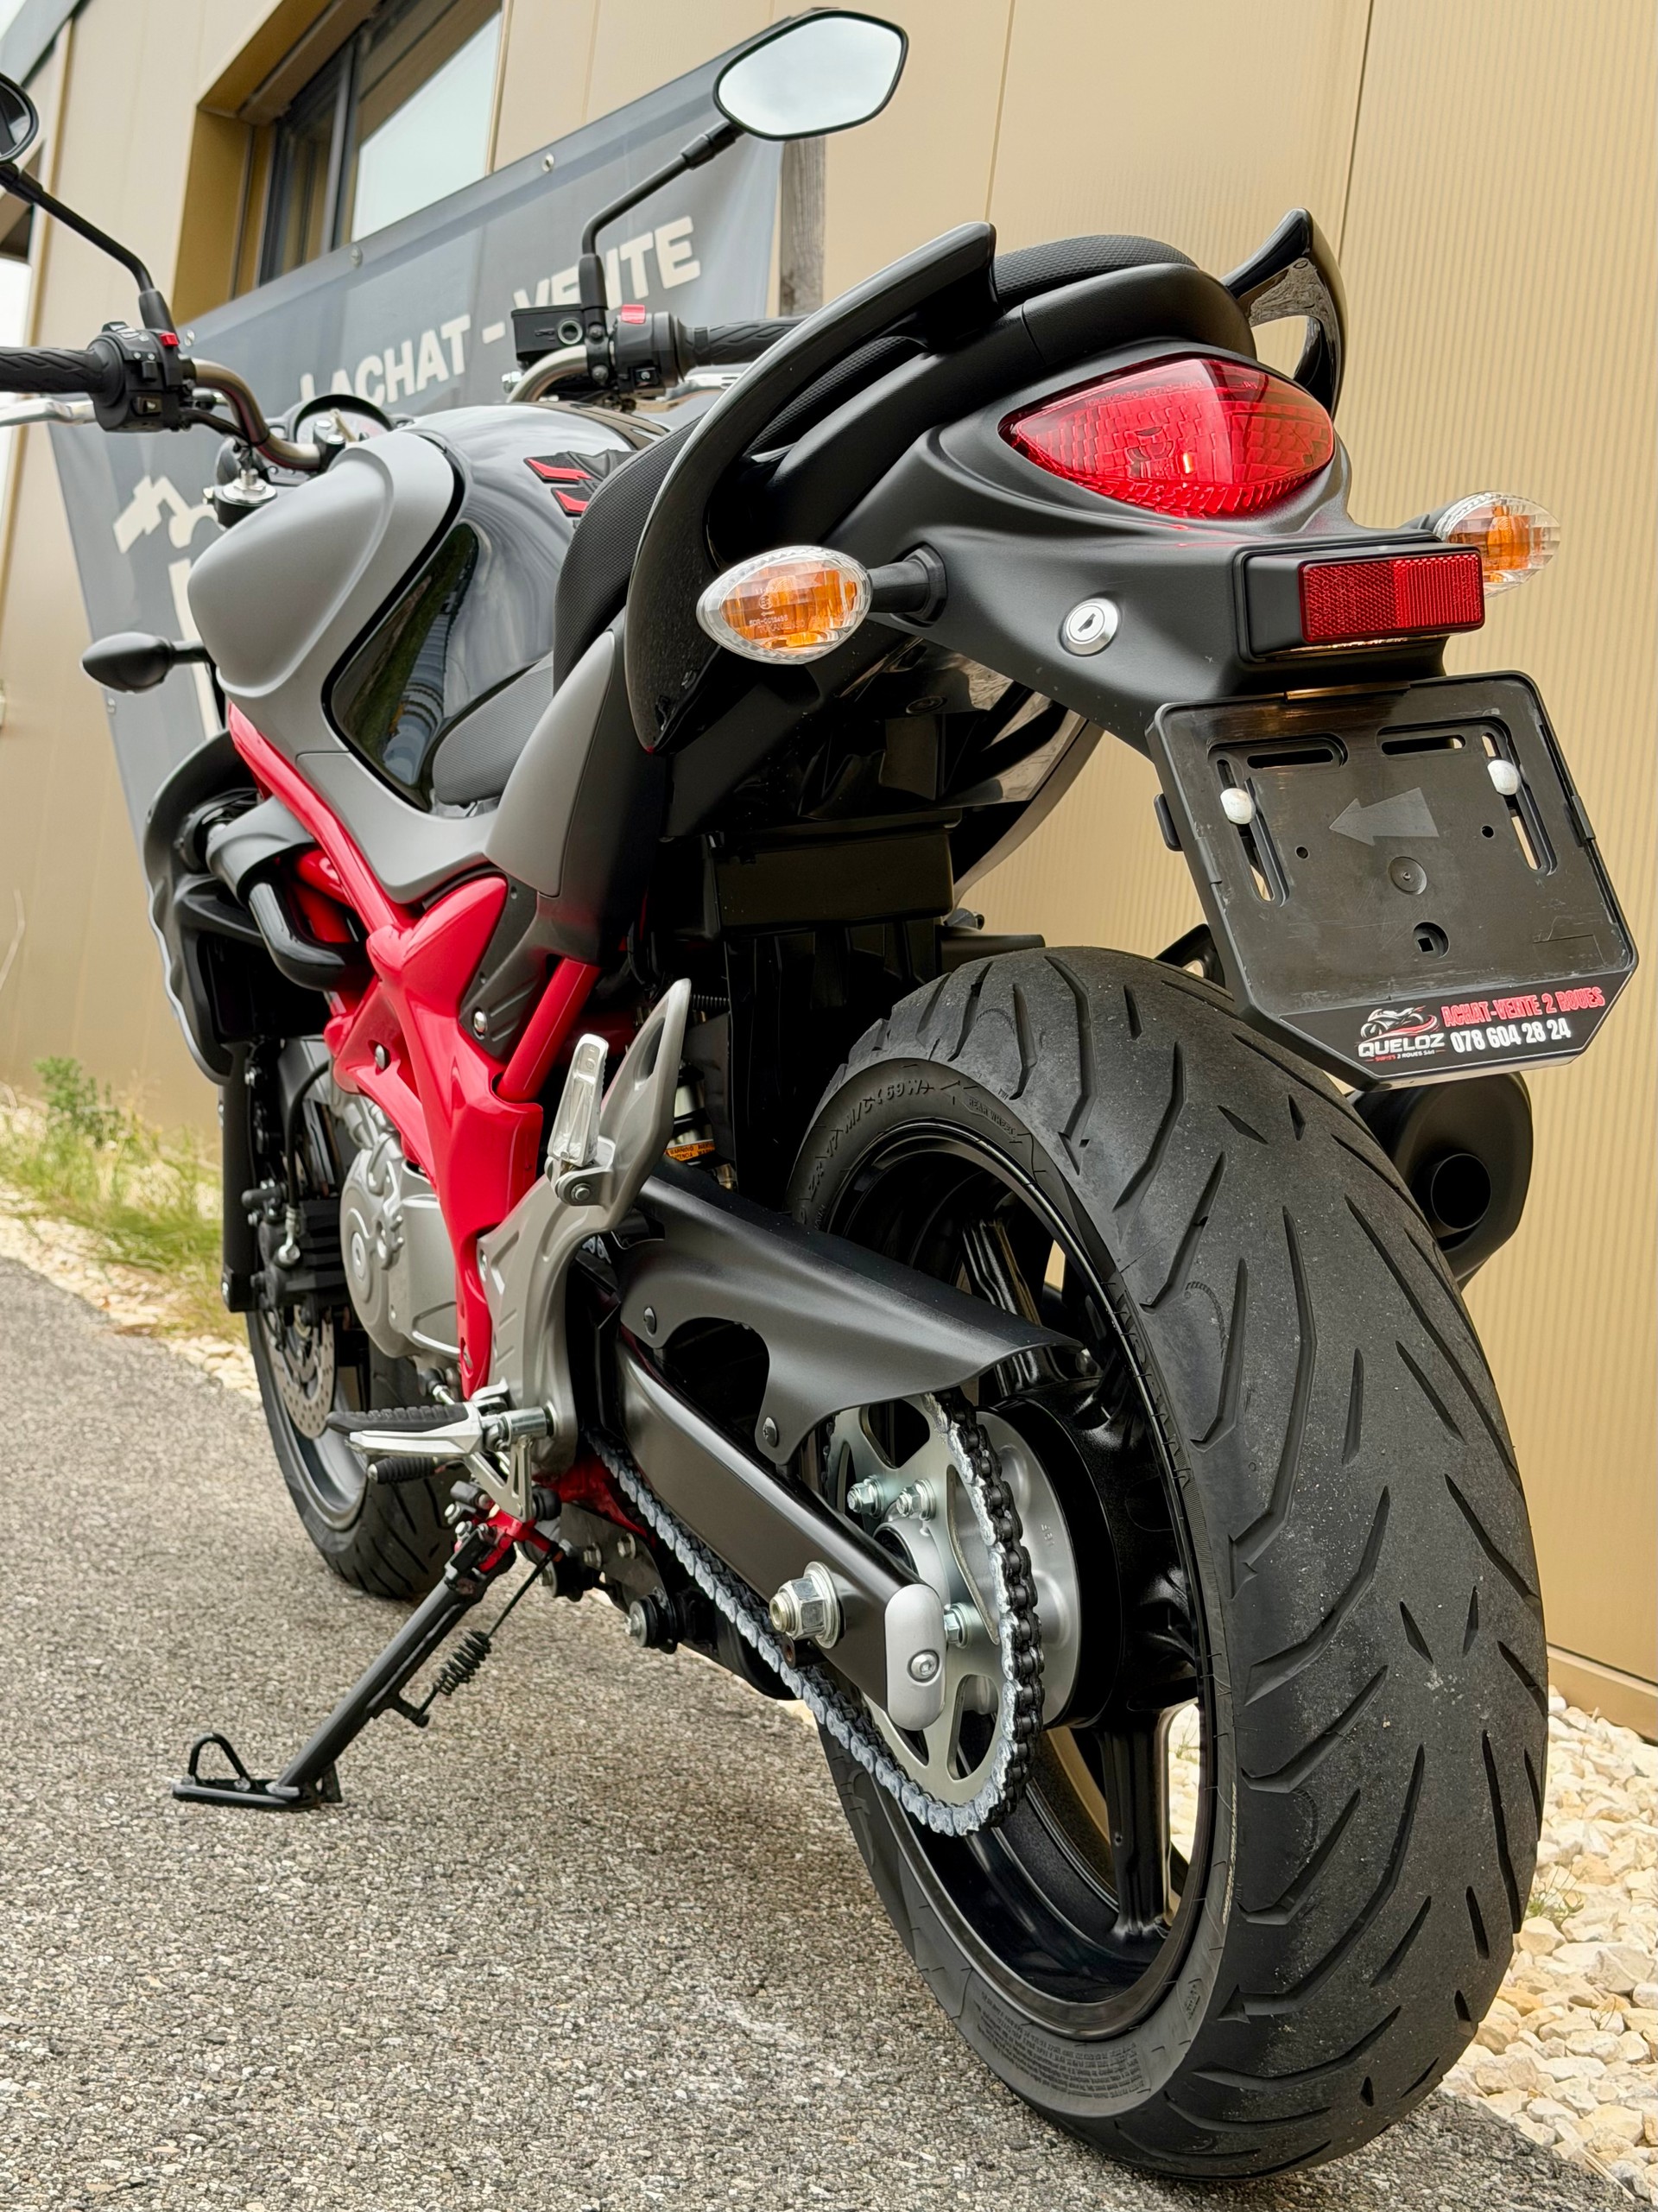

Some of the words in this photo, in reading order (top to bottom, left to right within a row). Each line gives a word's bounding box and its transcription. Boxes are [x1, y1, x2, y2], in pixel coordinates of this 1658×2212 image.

[1440, 994, 1542, 1027] ACHAT-VENTE
[1541, 992, 1557, 1014] 2
[1554, 986, 1606, 1012] ROUES
[1357, 1032, 1446, 1057] QUELOZ
[1450, 1029, 1486, 1054] 078
[1486, 1024, 1522, 1049] 604
[1522, 1021, 1546, 1044] 28
[1547, 1017, 1572, 1040] 24
[1402, 1050, 1423, 1059] ROUES
